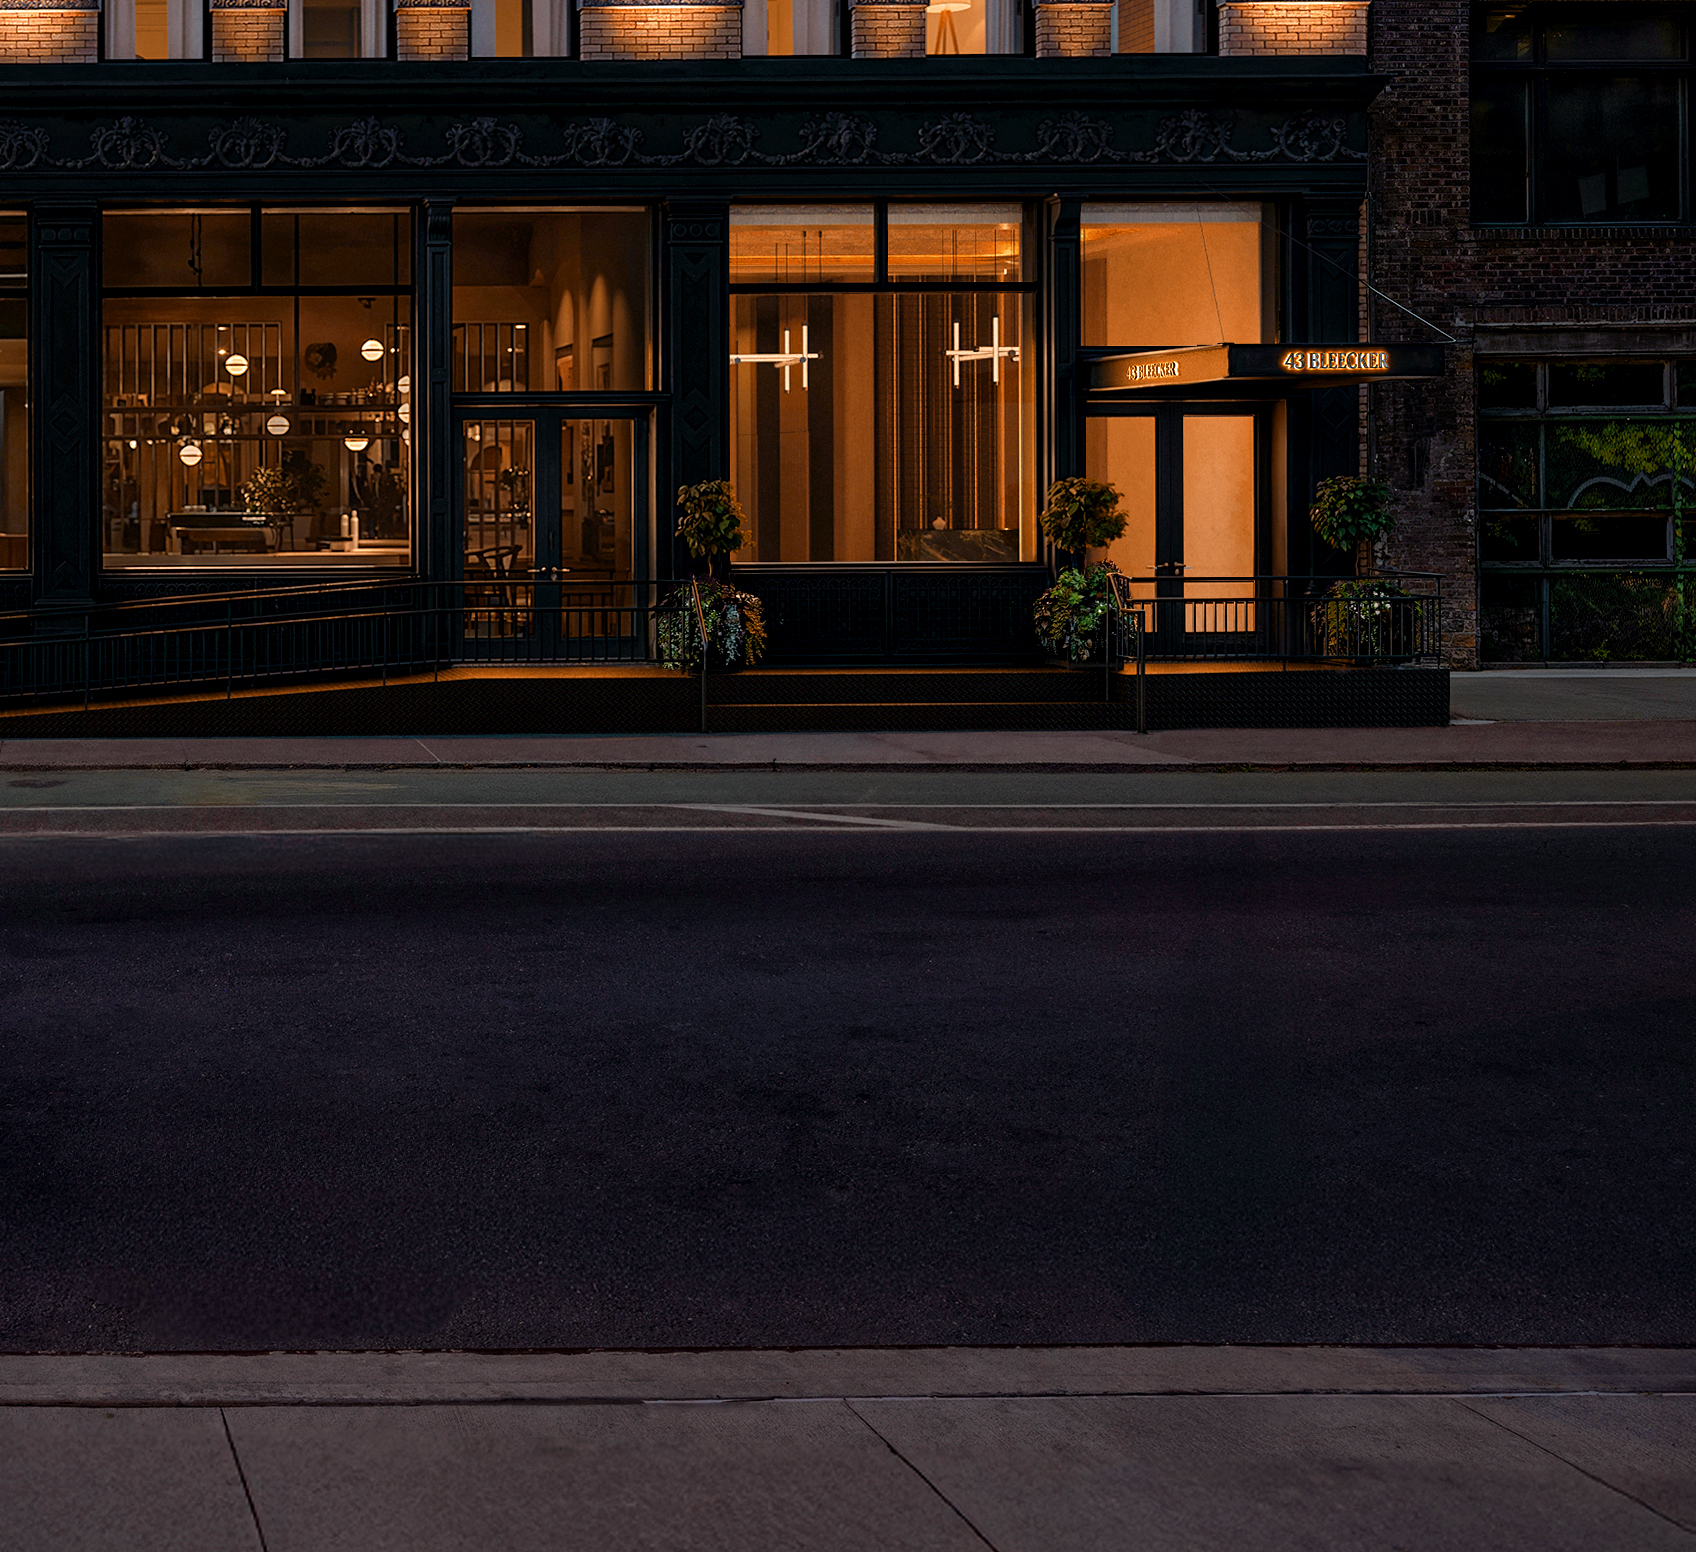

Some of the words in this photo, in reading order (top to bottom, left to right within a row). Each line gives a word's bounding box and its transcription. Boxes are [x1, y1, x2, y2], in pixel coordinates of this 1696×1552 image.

[1283, 352, 1305, 369] 43
[1307, 352, 1389, 369] BLEECKER
[1138, 361, 1179, 379] BLEECKER
